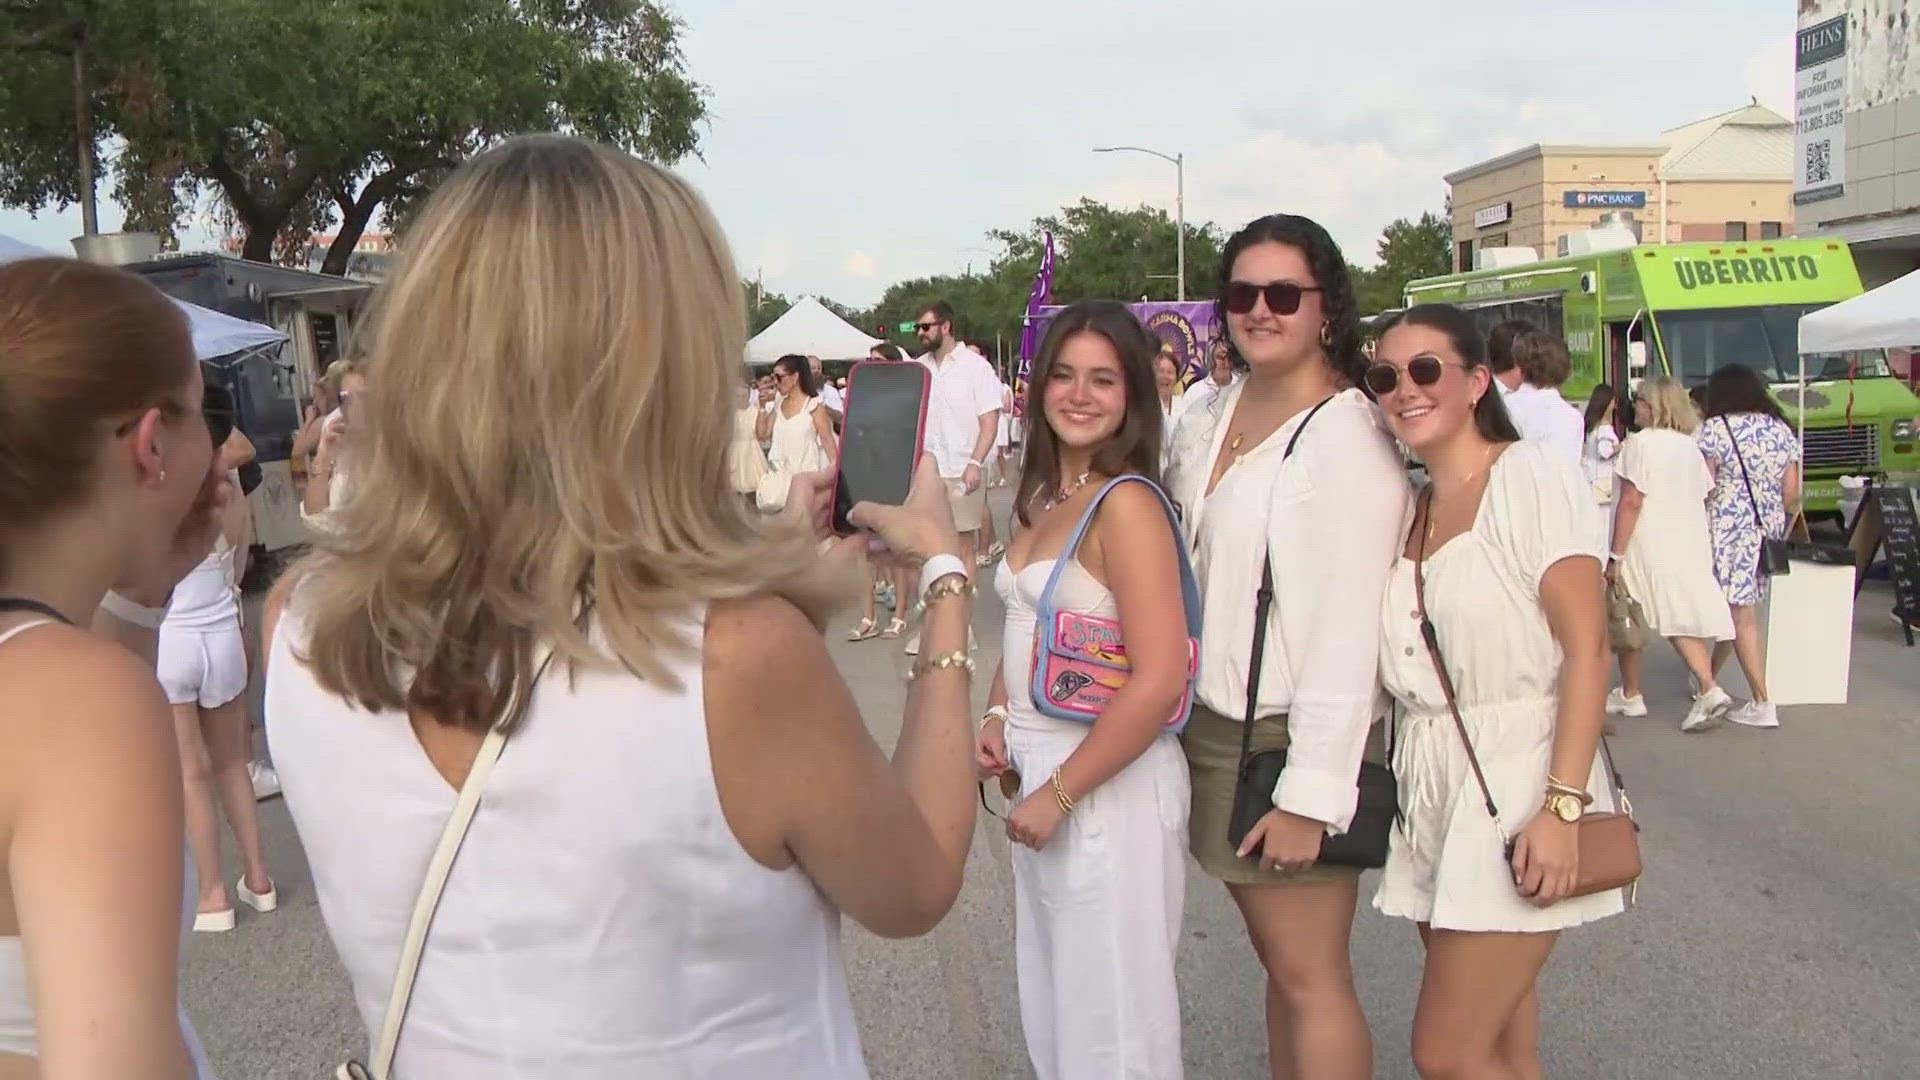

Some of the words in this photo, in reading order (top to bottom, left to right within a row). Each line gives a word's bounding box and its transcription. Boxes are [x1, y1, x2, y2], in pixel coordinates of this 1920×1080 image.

[1800, 22, 1843, 54] HEINS
[1812, 69, 1827, 83] FOR
[1796, 77, 1843, 100] INFORMATION
[1795, 109, 1844, 135] 713.805.3525
[1587, 193, 1608, 204] PNC
[1609, 193, 1635, 204] BANK
[1673, 254, 1819, 290] ÜBERRITO
[1567, 330, 1594, 352] BUILT
